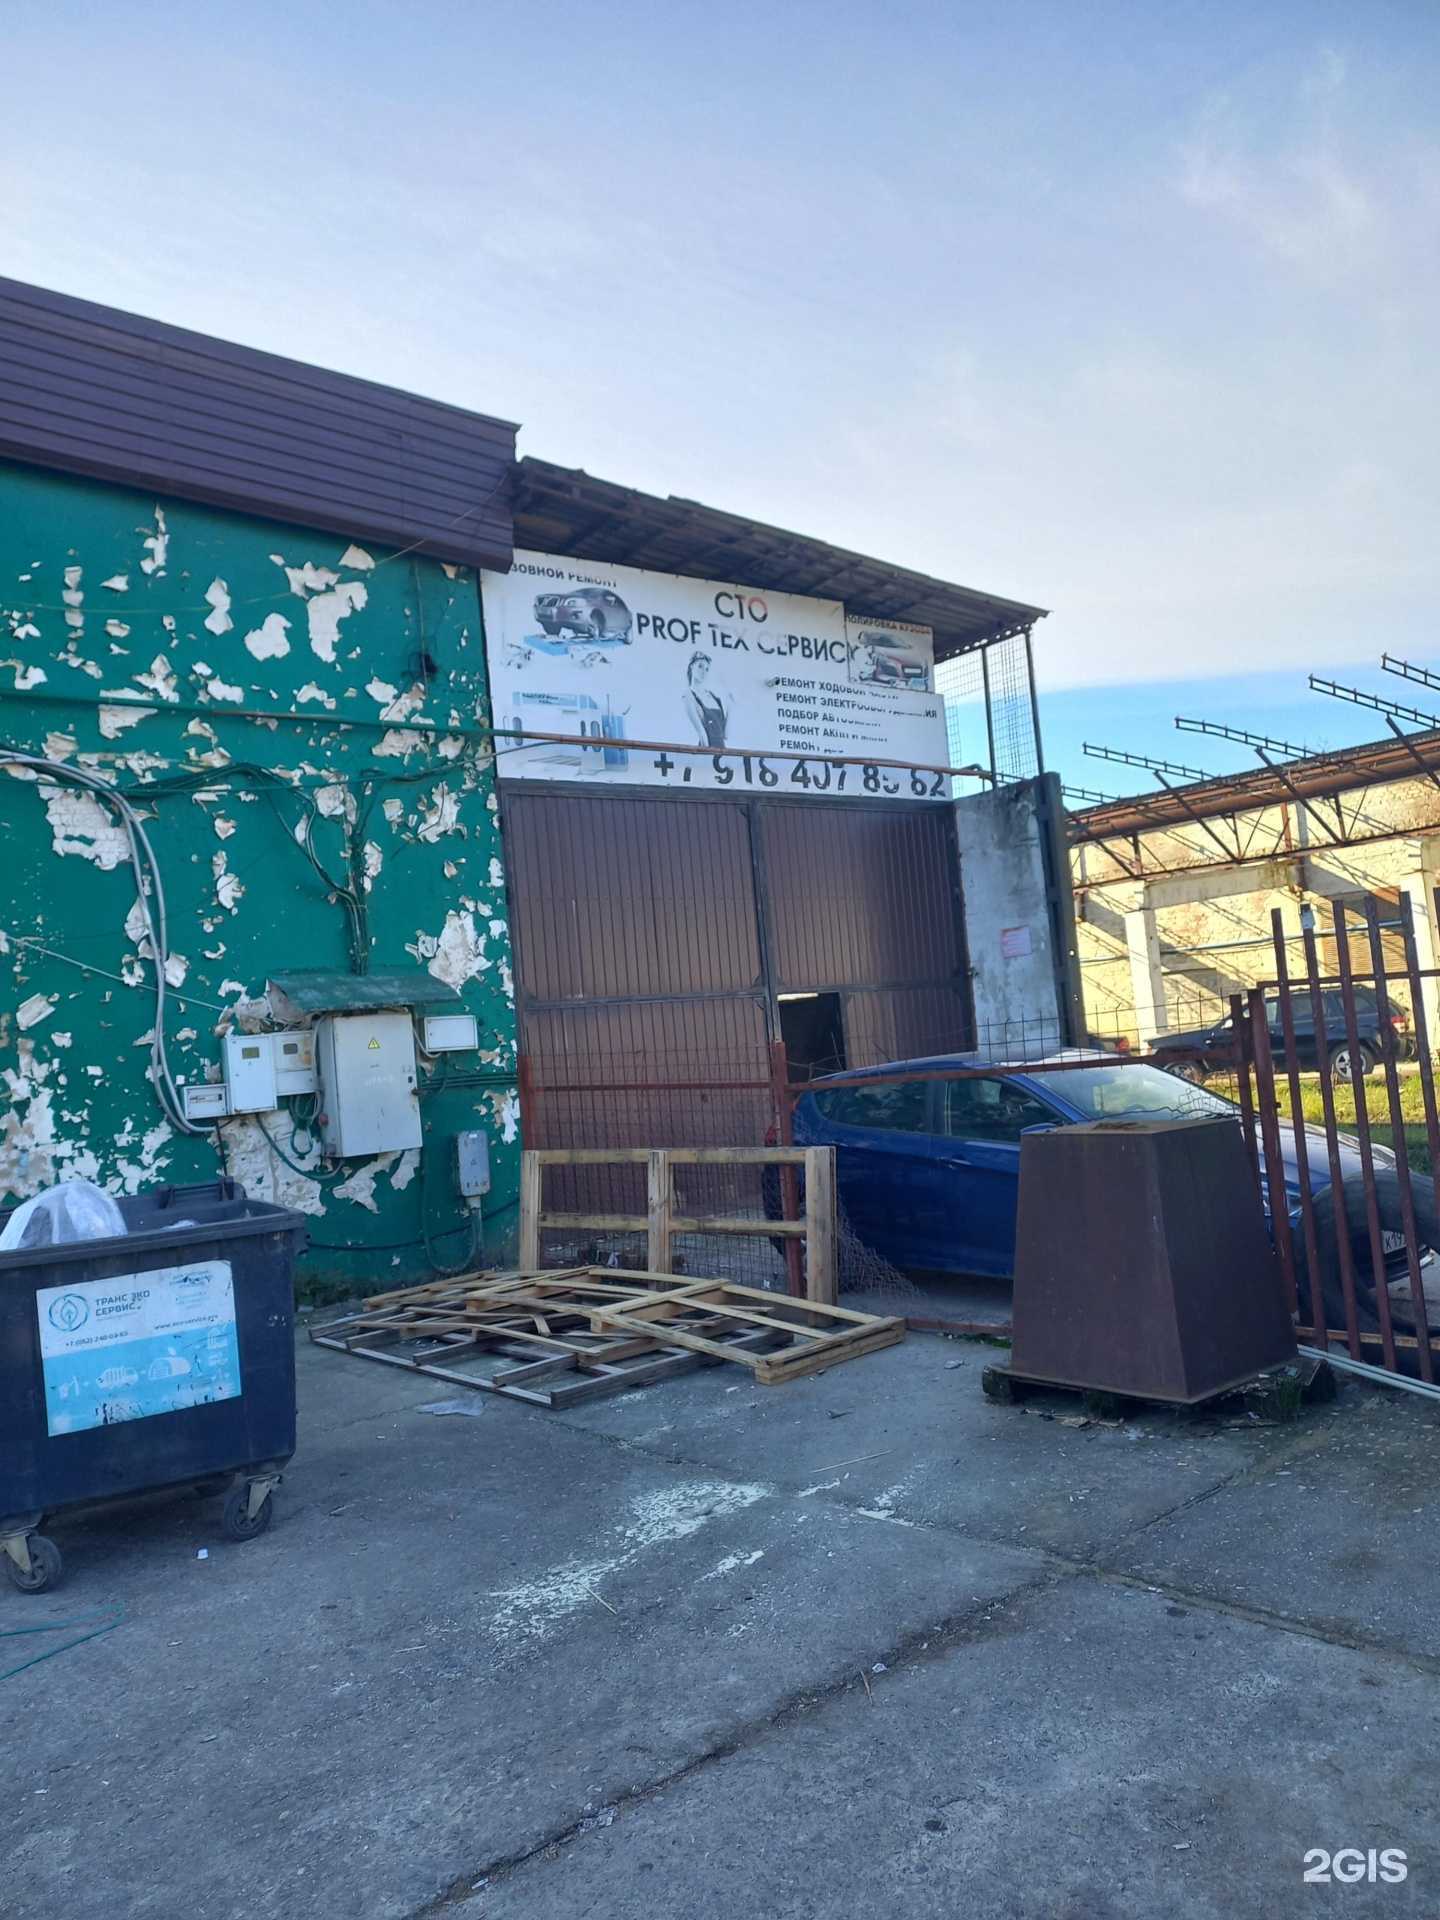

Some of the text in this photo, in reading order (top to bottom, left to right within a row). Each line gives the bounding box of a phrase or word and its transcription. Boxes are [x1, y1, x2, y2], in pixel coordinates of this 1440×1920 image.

[714, 591, 768, 623] СТО
[636, 612, 702, 644] PROF
[776, 692, 817, 705] РЕМОНТ
[777, 708, 819, 721] ПОДБОР
[778, 723, 820, 737] РЕМОНТ
[95, 1293, 128, 1307] ТРАНС
[95, 1303, 136, 1317] СЕРВИС
